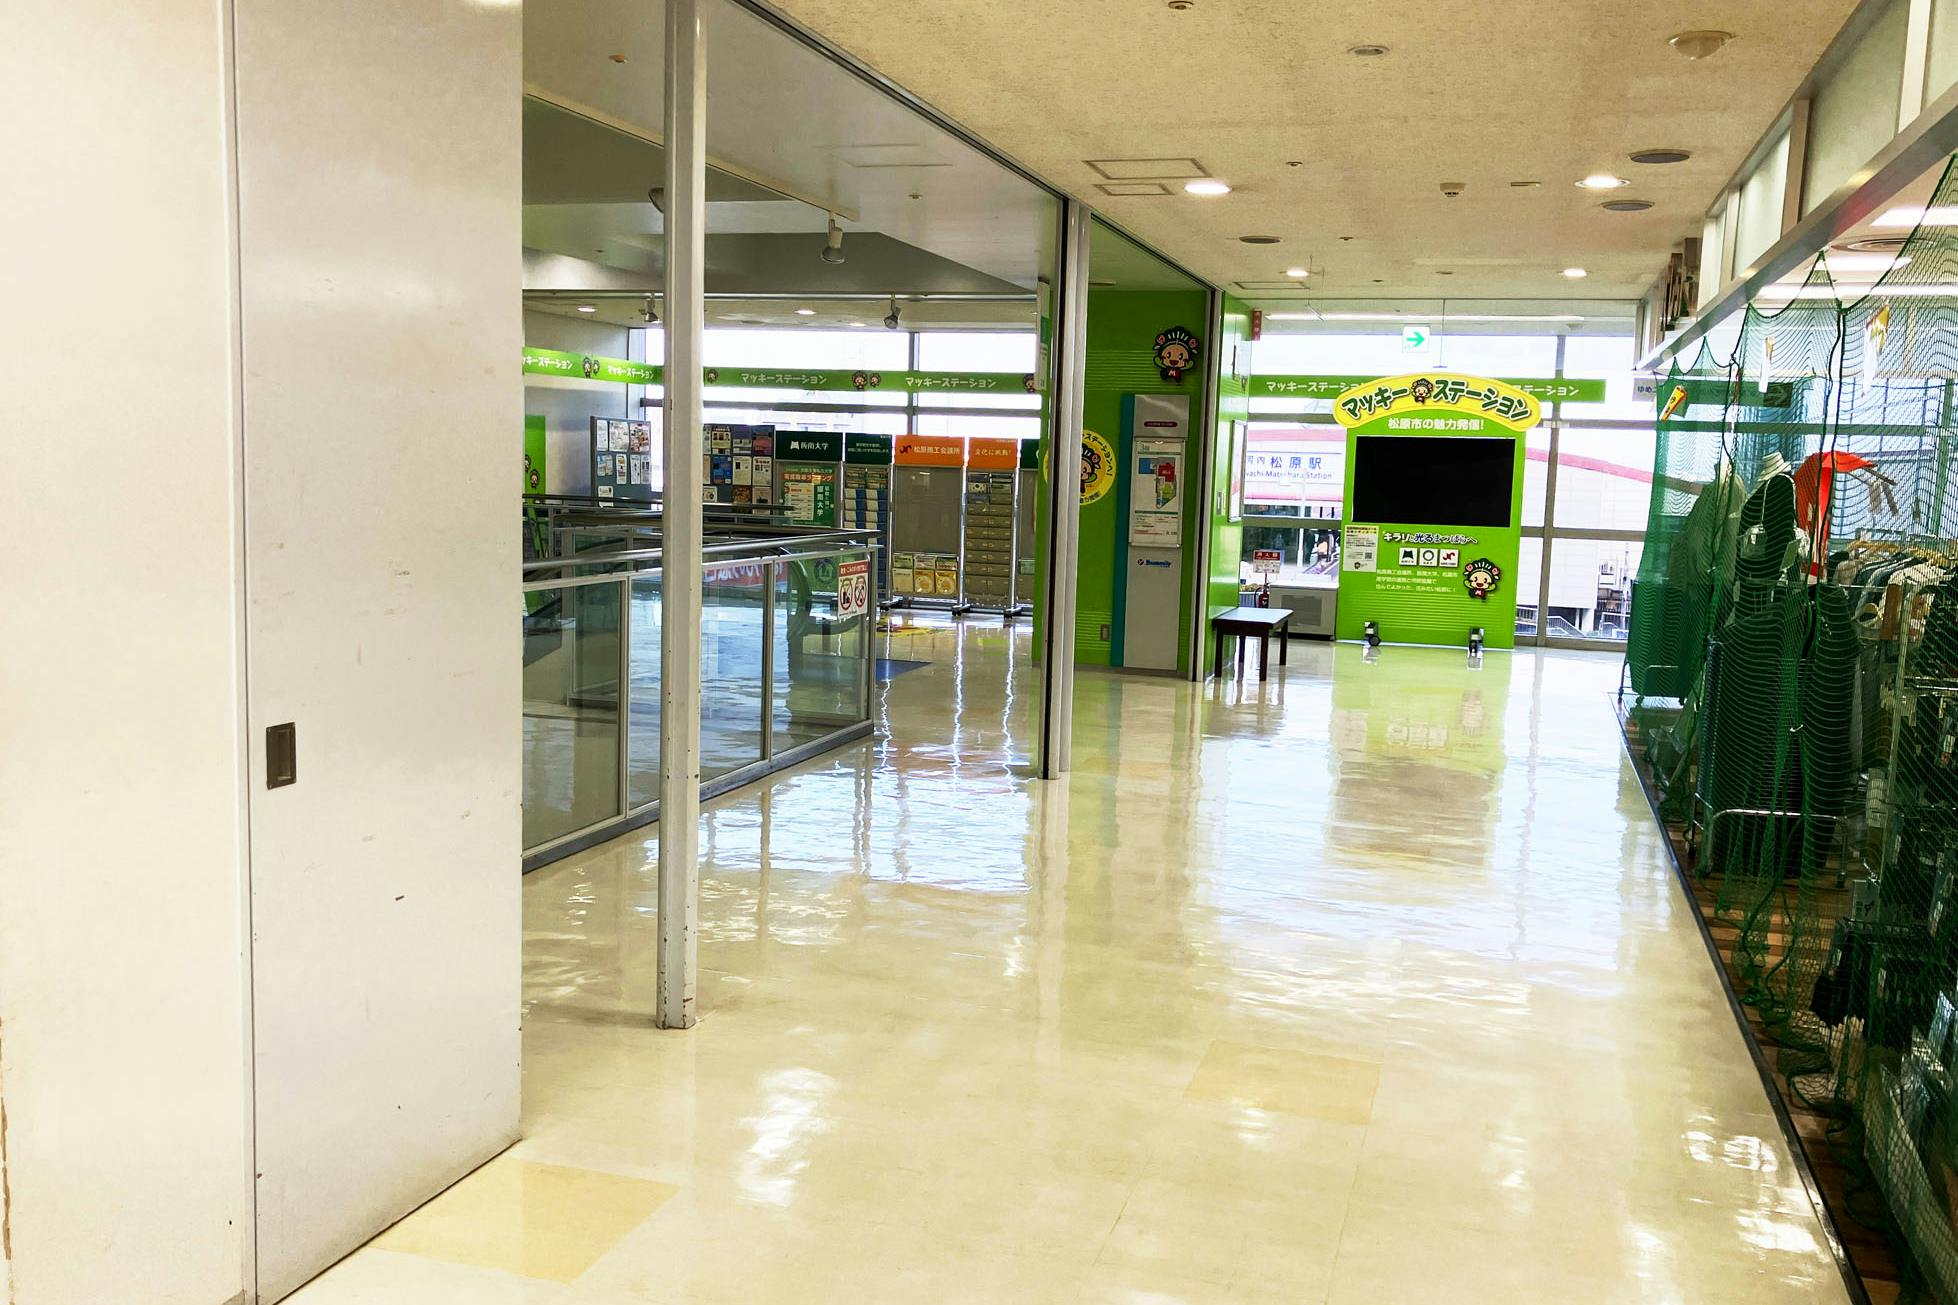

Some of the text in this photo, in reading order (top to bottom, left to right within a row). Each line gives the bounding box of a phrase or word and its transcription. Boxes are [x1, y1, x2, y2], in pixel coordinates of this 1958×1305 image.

[607, 365, 655, 379] マッキーステーション
[740, 372, 828, 385] マッキーステーション
[904, 376, 997, 389] マッキーステーション
[1266, 381, 1363, 392] マッキーステーショ
[1341, 378, 1533, 420] マッキー ステーション
[1388, 417, 1484, 431] 松原市の魅力発信!
[1083, 433, 1113, 477] ステーションへ!
